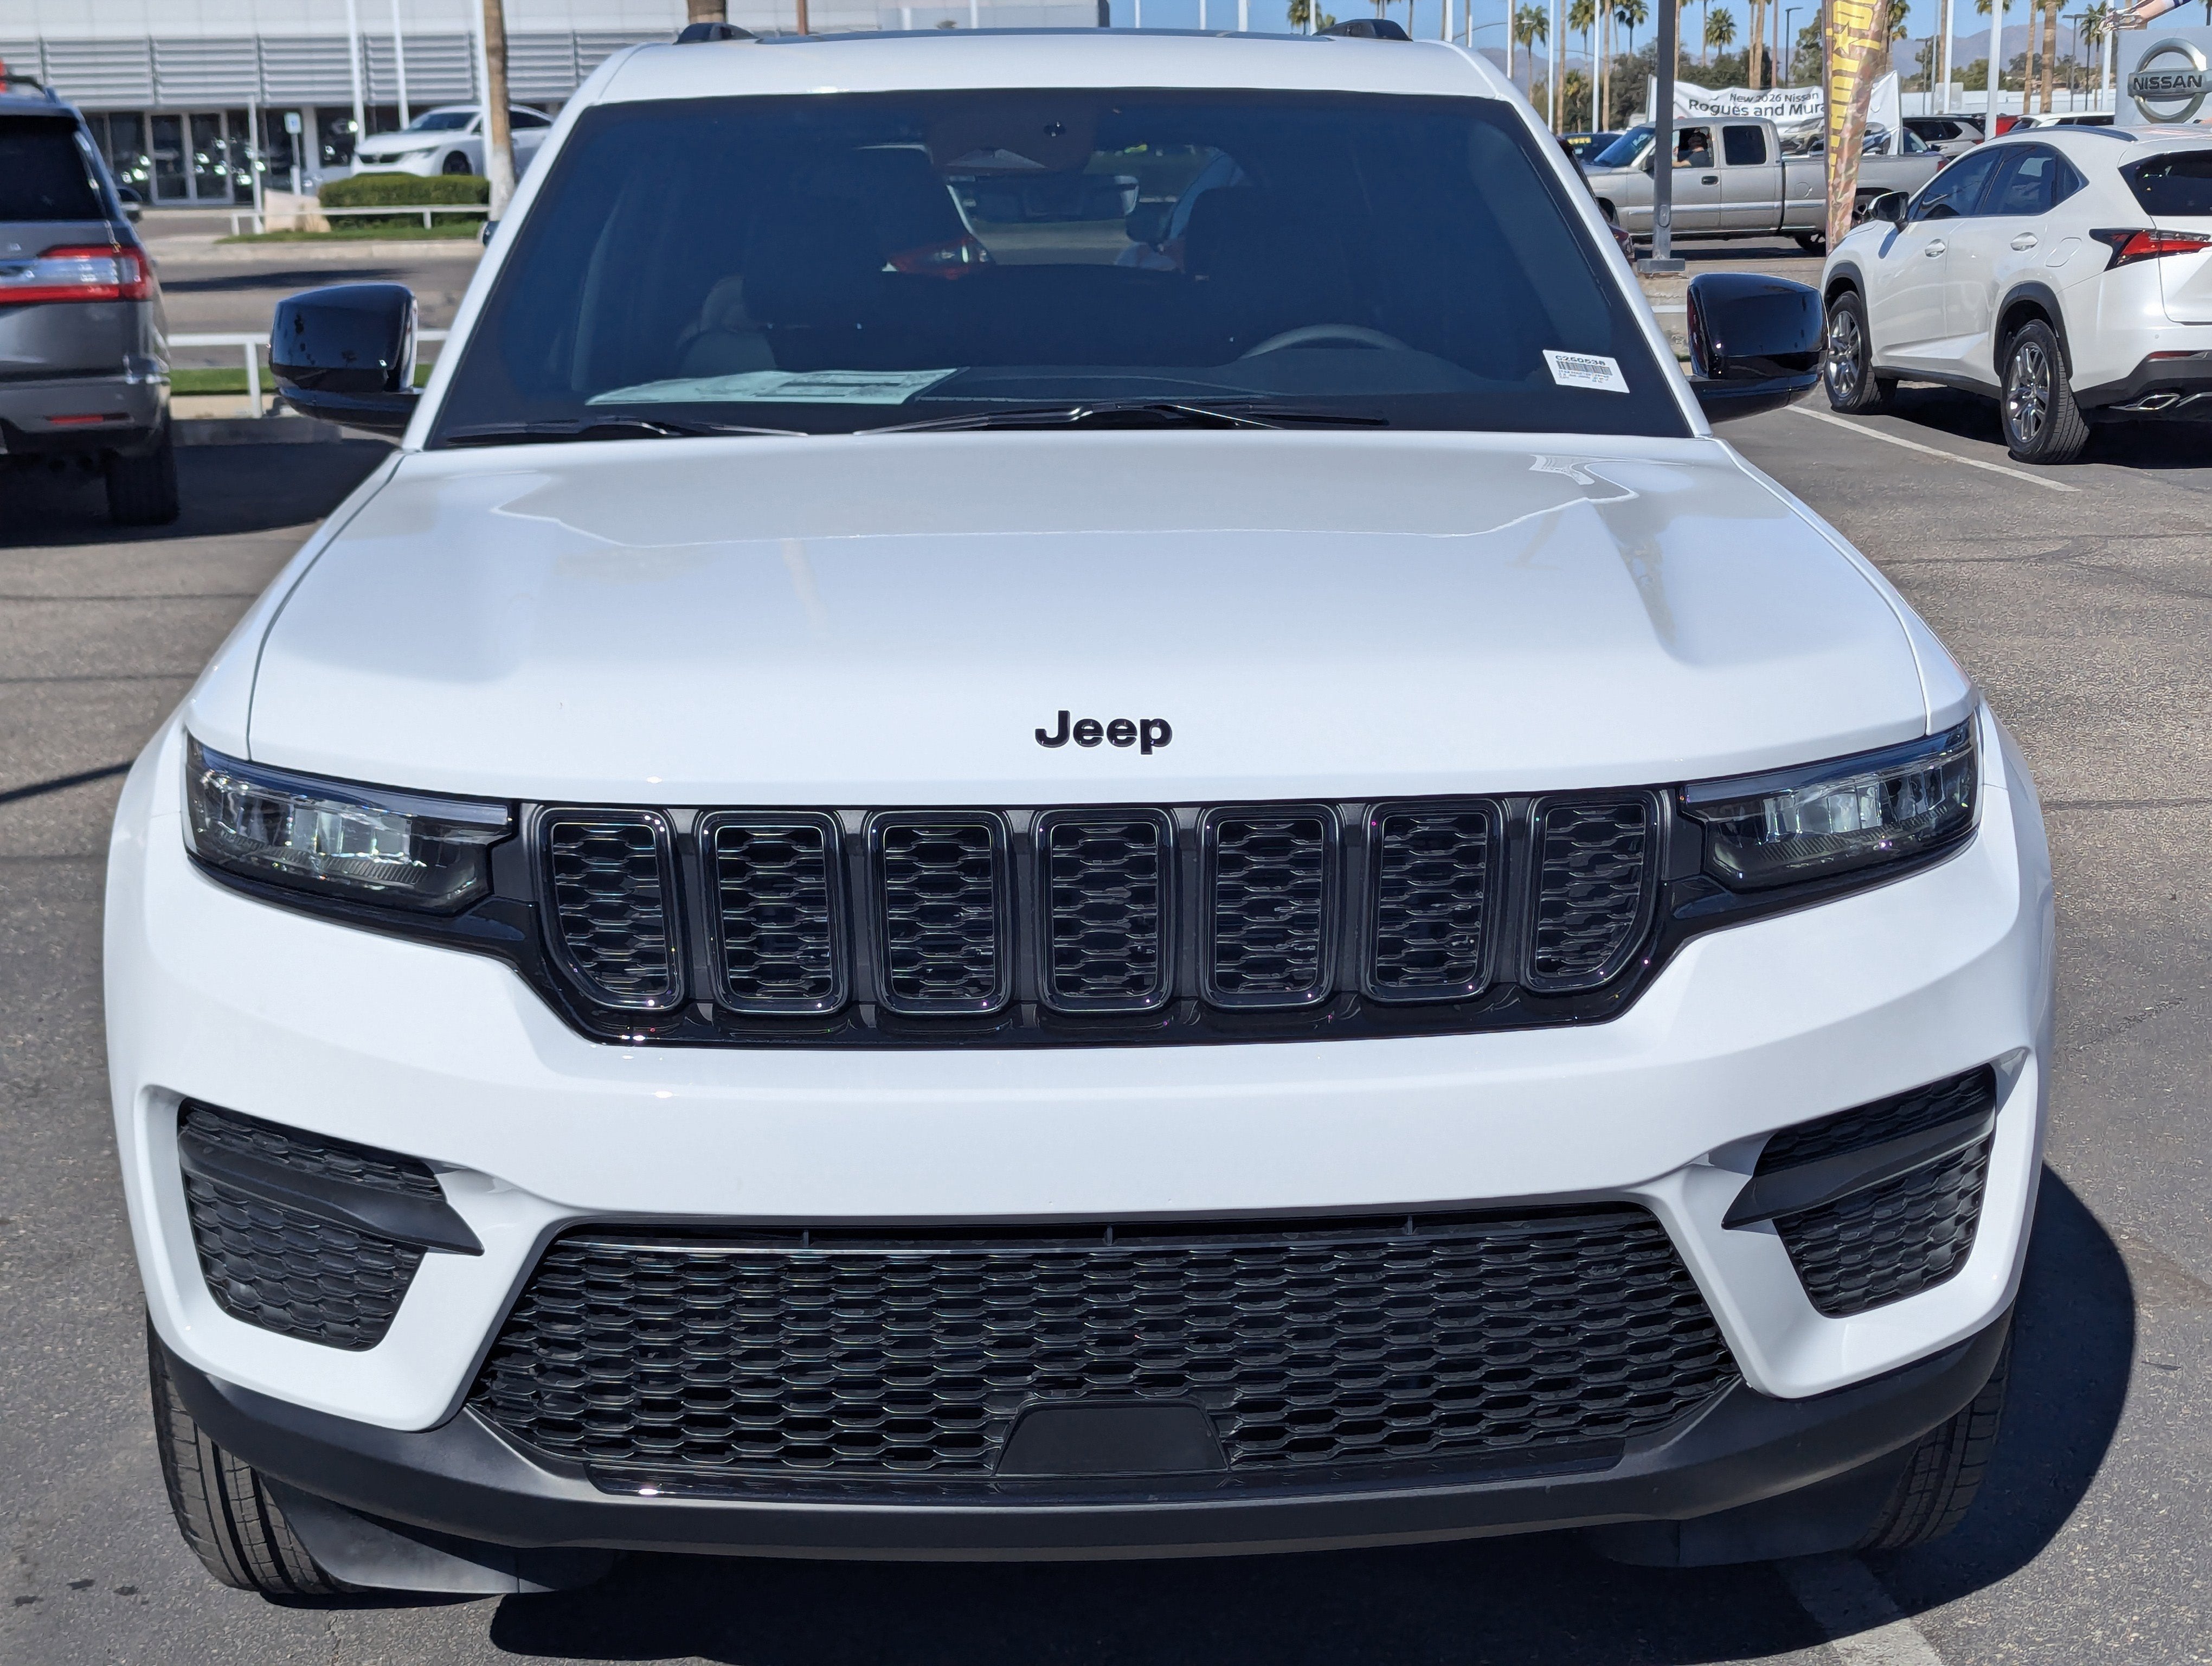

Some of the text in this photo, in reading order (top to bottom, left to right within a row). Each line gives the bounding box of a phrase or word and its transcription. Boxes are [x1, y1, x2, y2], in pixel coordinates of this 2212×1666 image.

[2133, 75, 2202, 90] NISSAN
[1729, 92, 1819, 103] New 2026 Nissan
[1689, 99, 1748, 116] Rogues
[1754, 103, 1784, 116] and
[1035, 710, 1173, 755] Jeep
